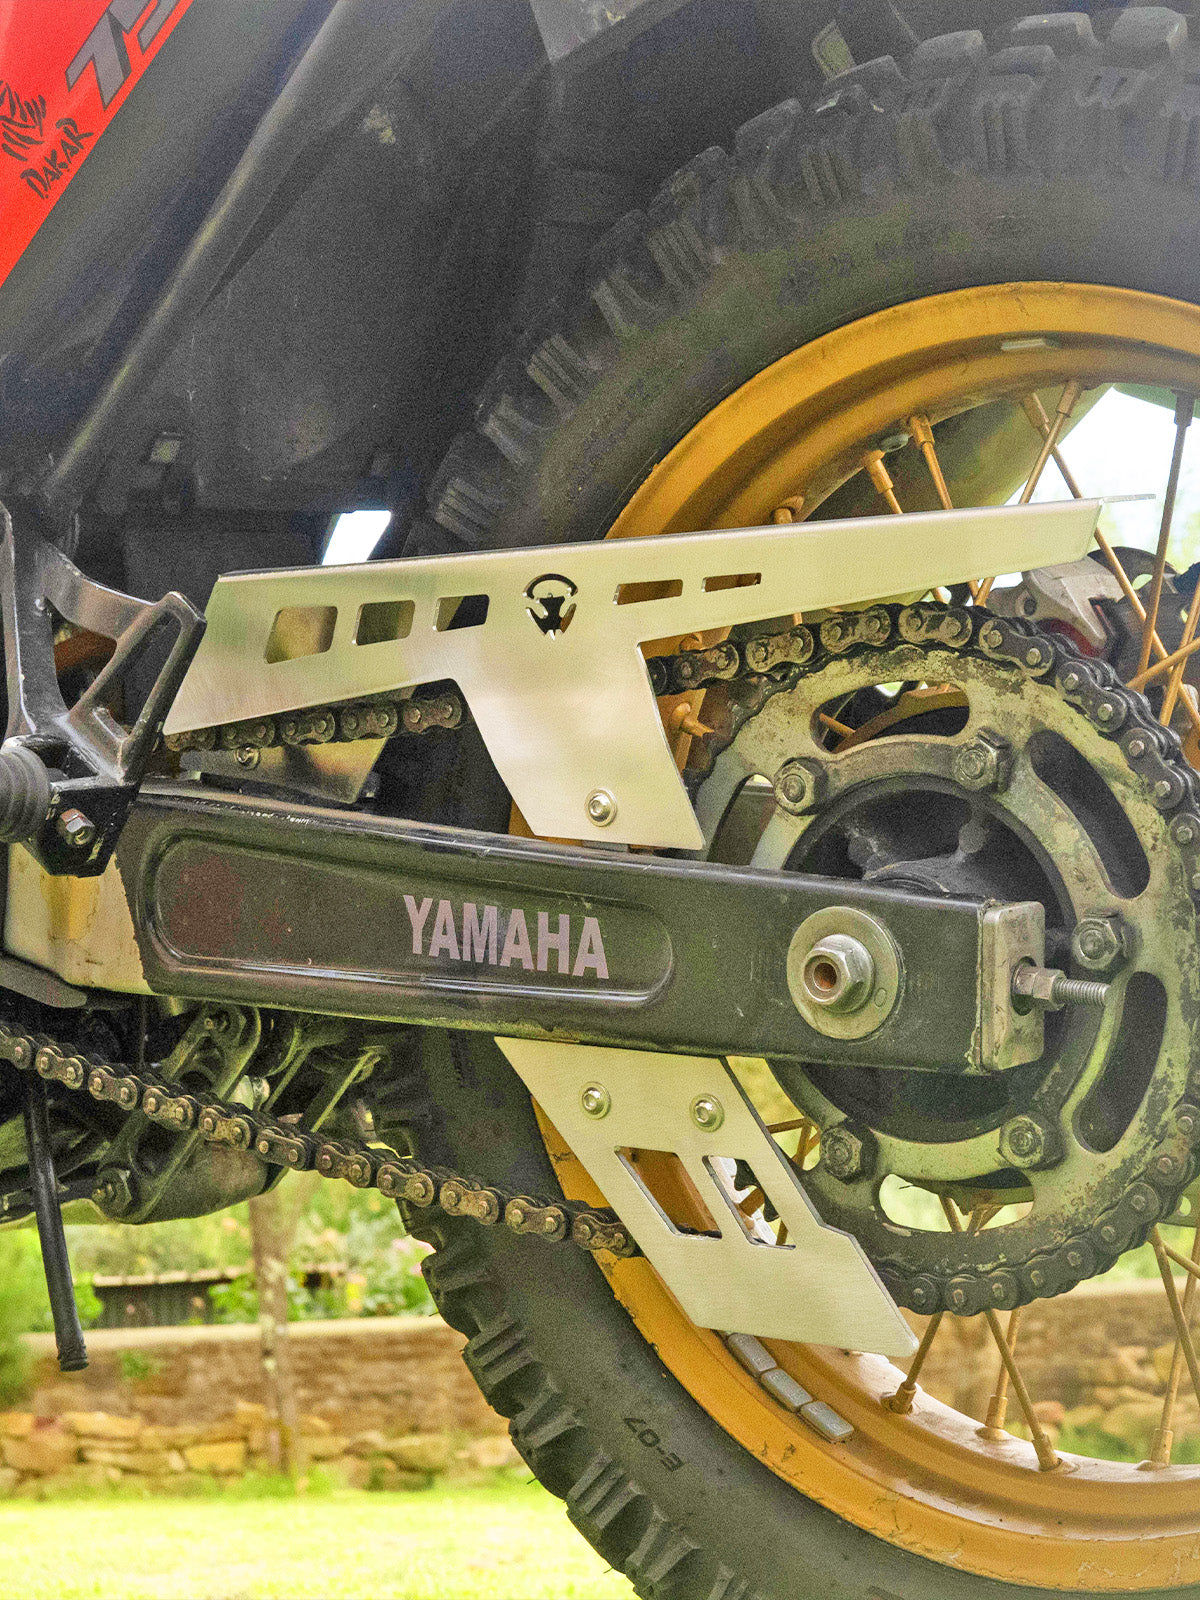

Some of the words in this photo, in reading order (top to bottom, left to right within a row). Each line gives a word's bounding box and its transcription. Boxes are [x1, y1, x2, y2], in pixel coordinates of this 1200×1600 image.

[20, 117, 94, 200] DAKAR
[403, 894, 609, 979] YAMAHA
[623, 1417, 684, 1472] E-07
